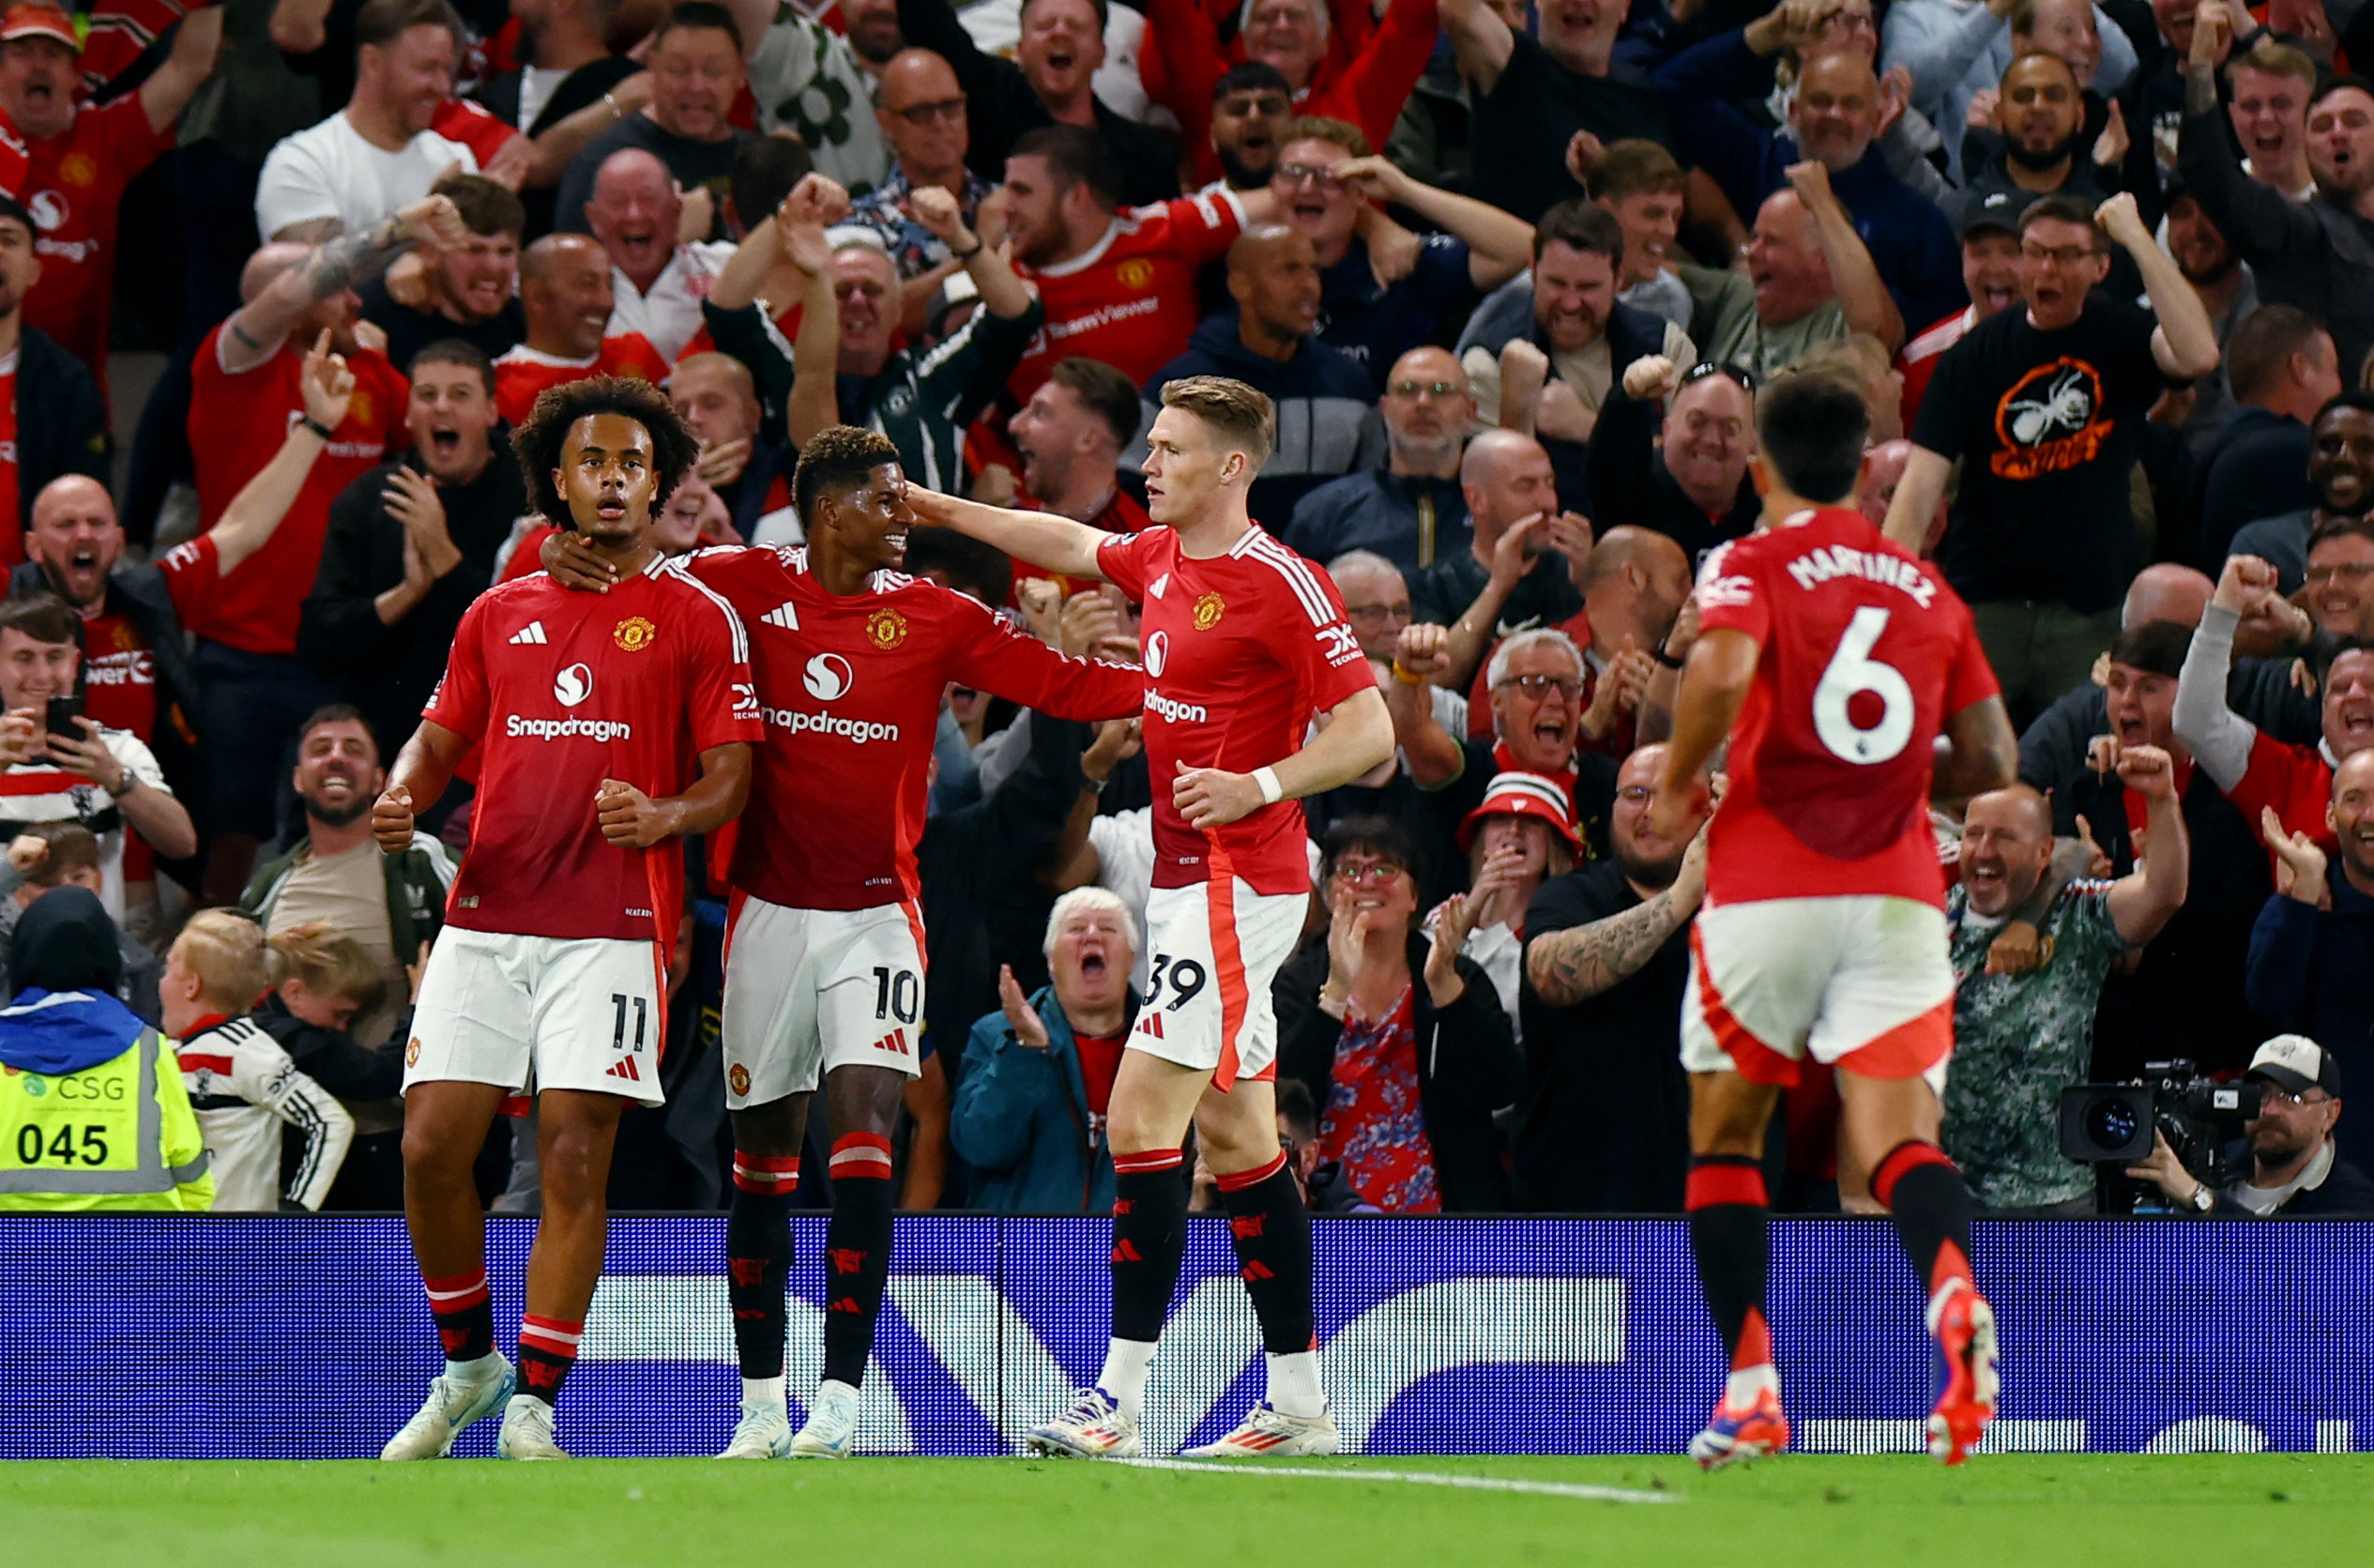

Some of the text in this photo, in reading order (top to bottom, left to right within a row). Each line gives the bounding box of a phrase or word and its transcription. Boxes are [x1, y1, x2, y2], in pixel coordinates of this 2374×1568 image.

[1787, 544, 1937, 609] MARTINEZ
[1145, 687, 1208, 723] dragon
[1812, 605, 1915, 765] 6
[507, 714, 631, 742] Snapdragon
[761, 706, 899, 744] napdragon
[873, 967, 919, 1025] 10
[1142, 953, 1207, 1012] 39
[612, 993, 647, 1052] 11
[58, 1075, 125, 1101] CSG
[17, 1123, 109, 1166] 045
